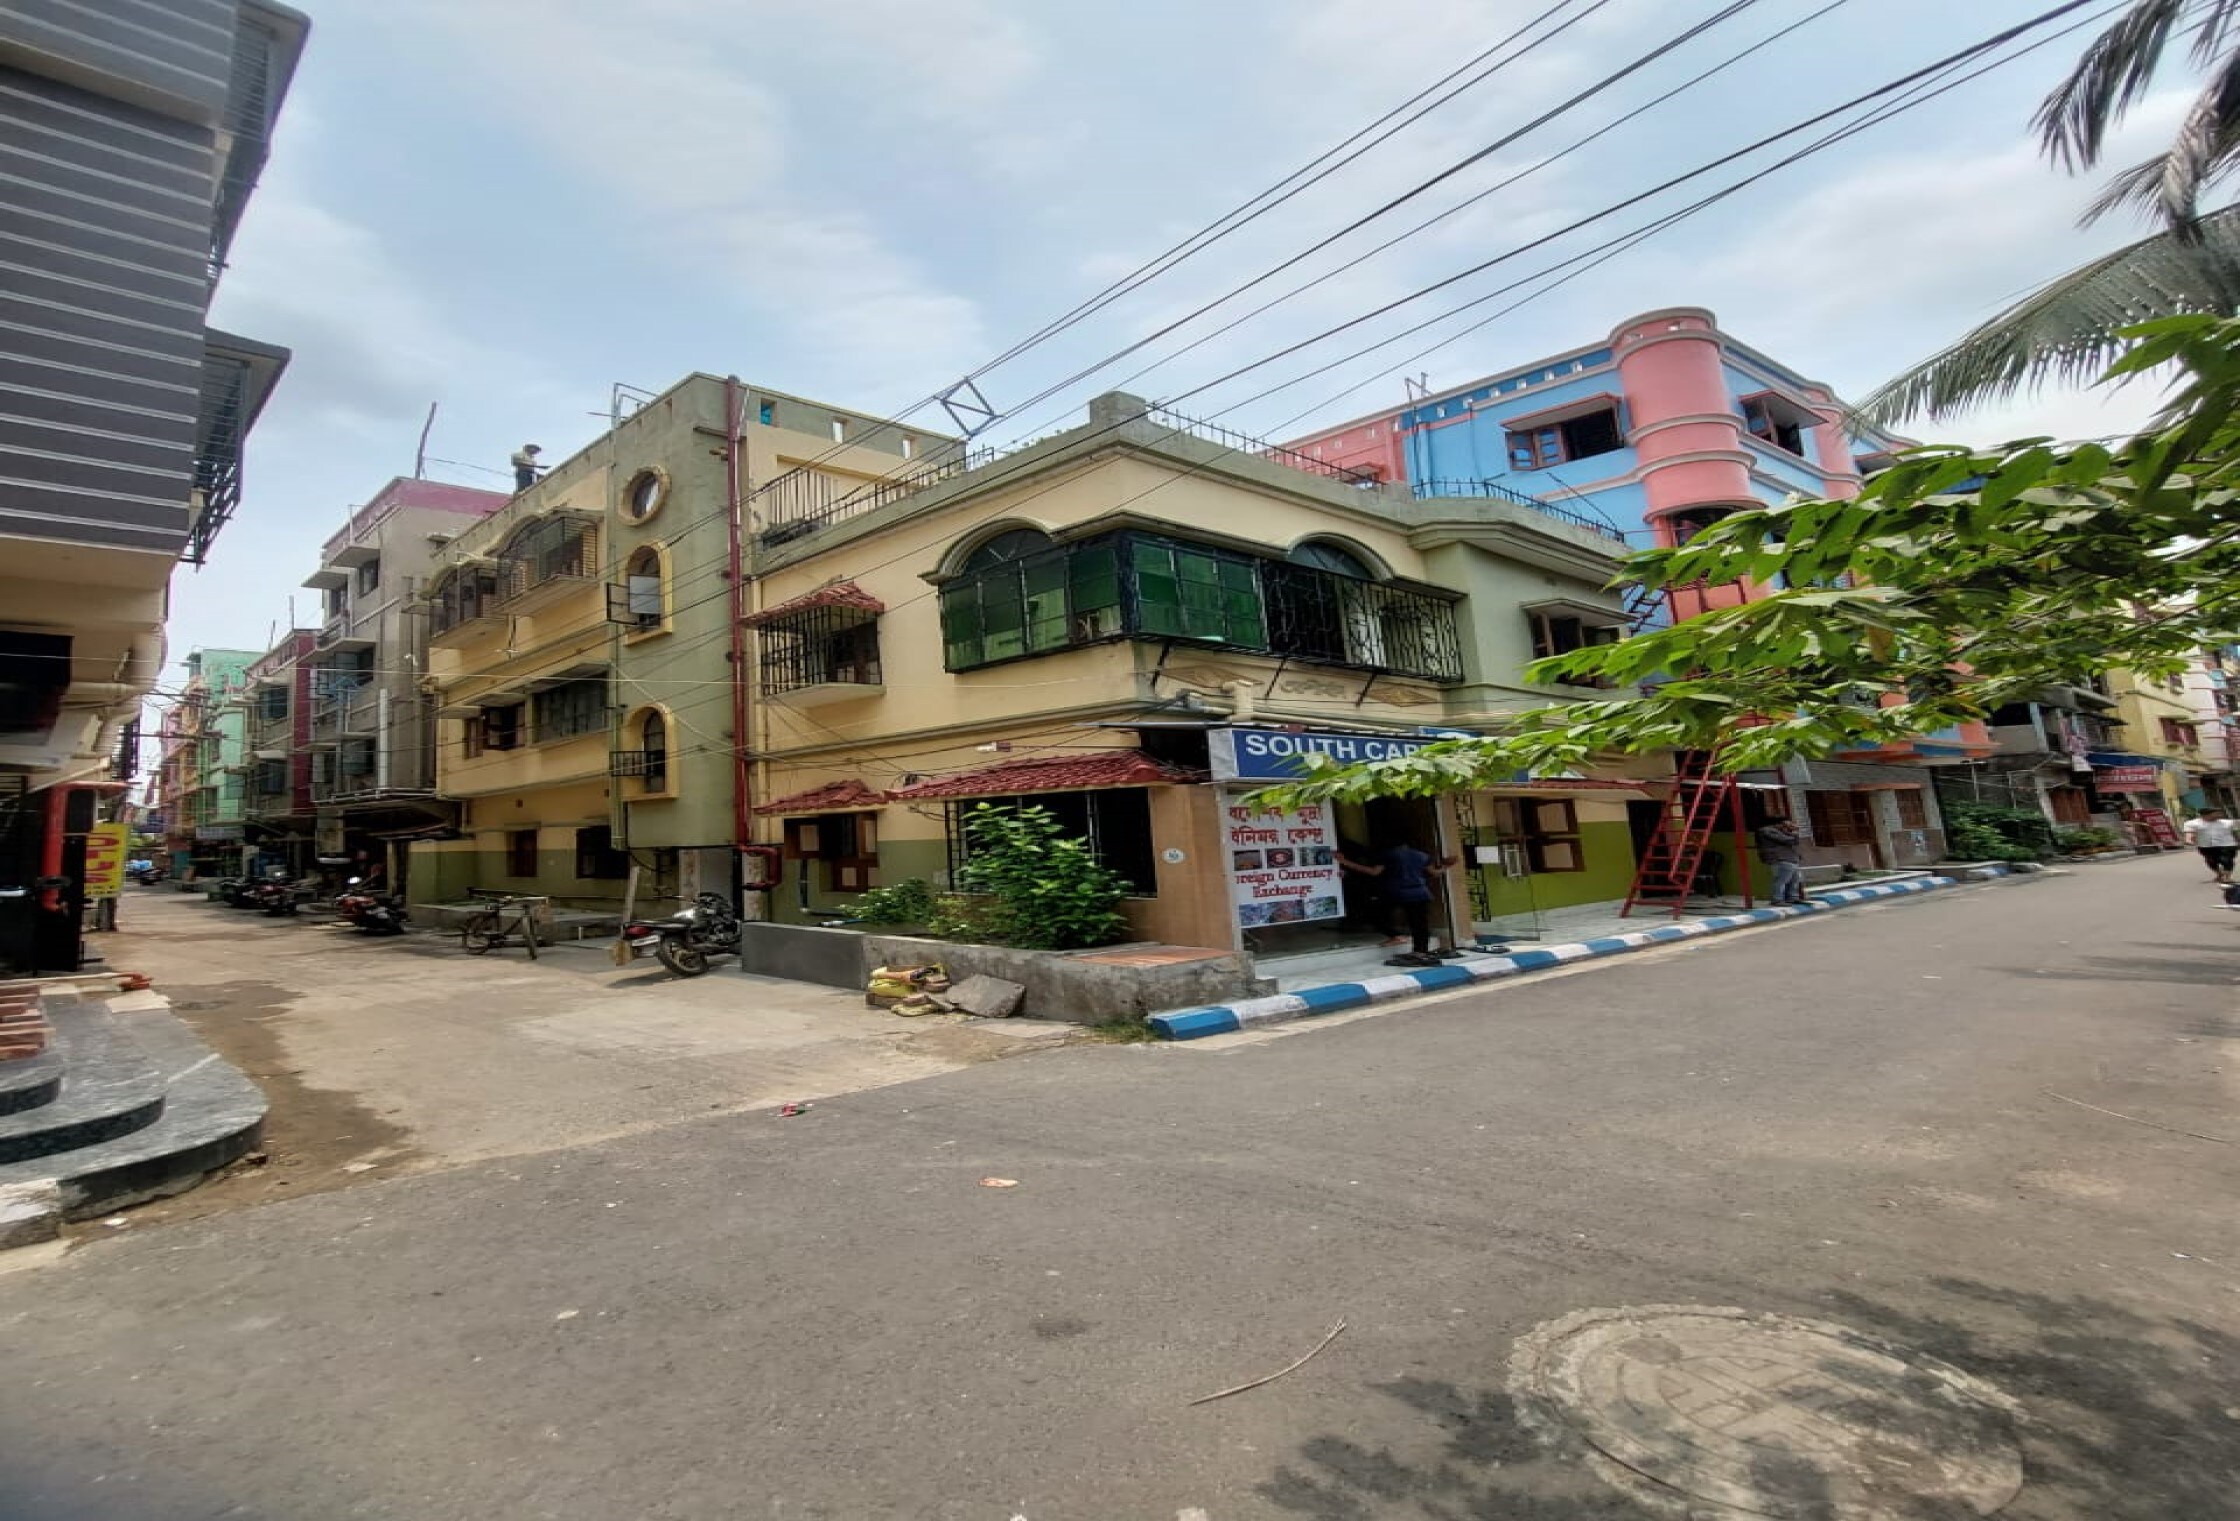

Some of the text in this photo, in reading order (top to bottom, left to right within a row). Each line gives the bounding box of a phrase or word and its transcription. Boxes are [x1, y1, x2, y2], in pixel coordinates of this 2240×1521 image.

[1245, 734, 1357, 761] SOUTH
[1279, 869, 1334, 881] Currency
[1252, 884, 1314, 898] Exchange
